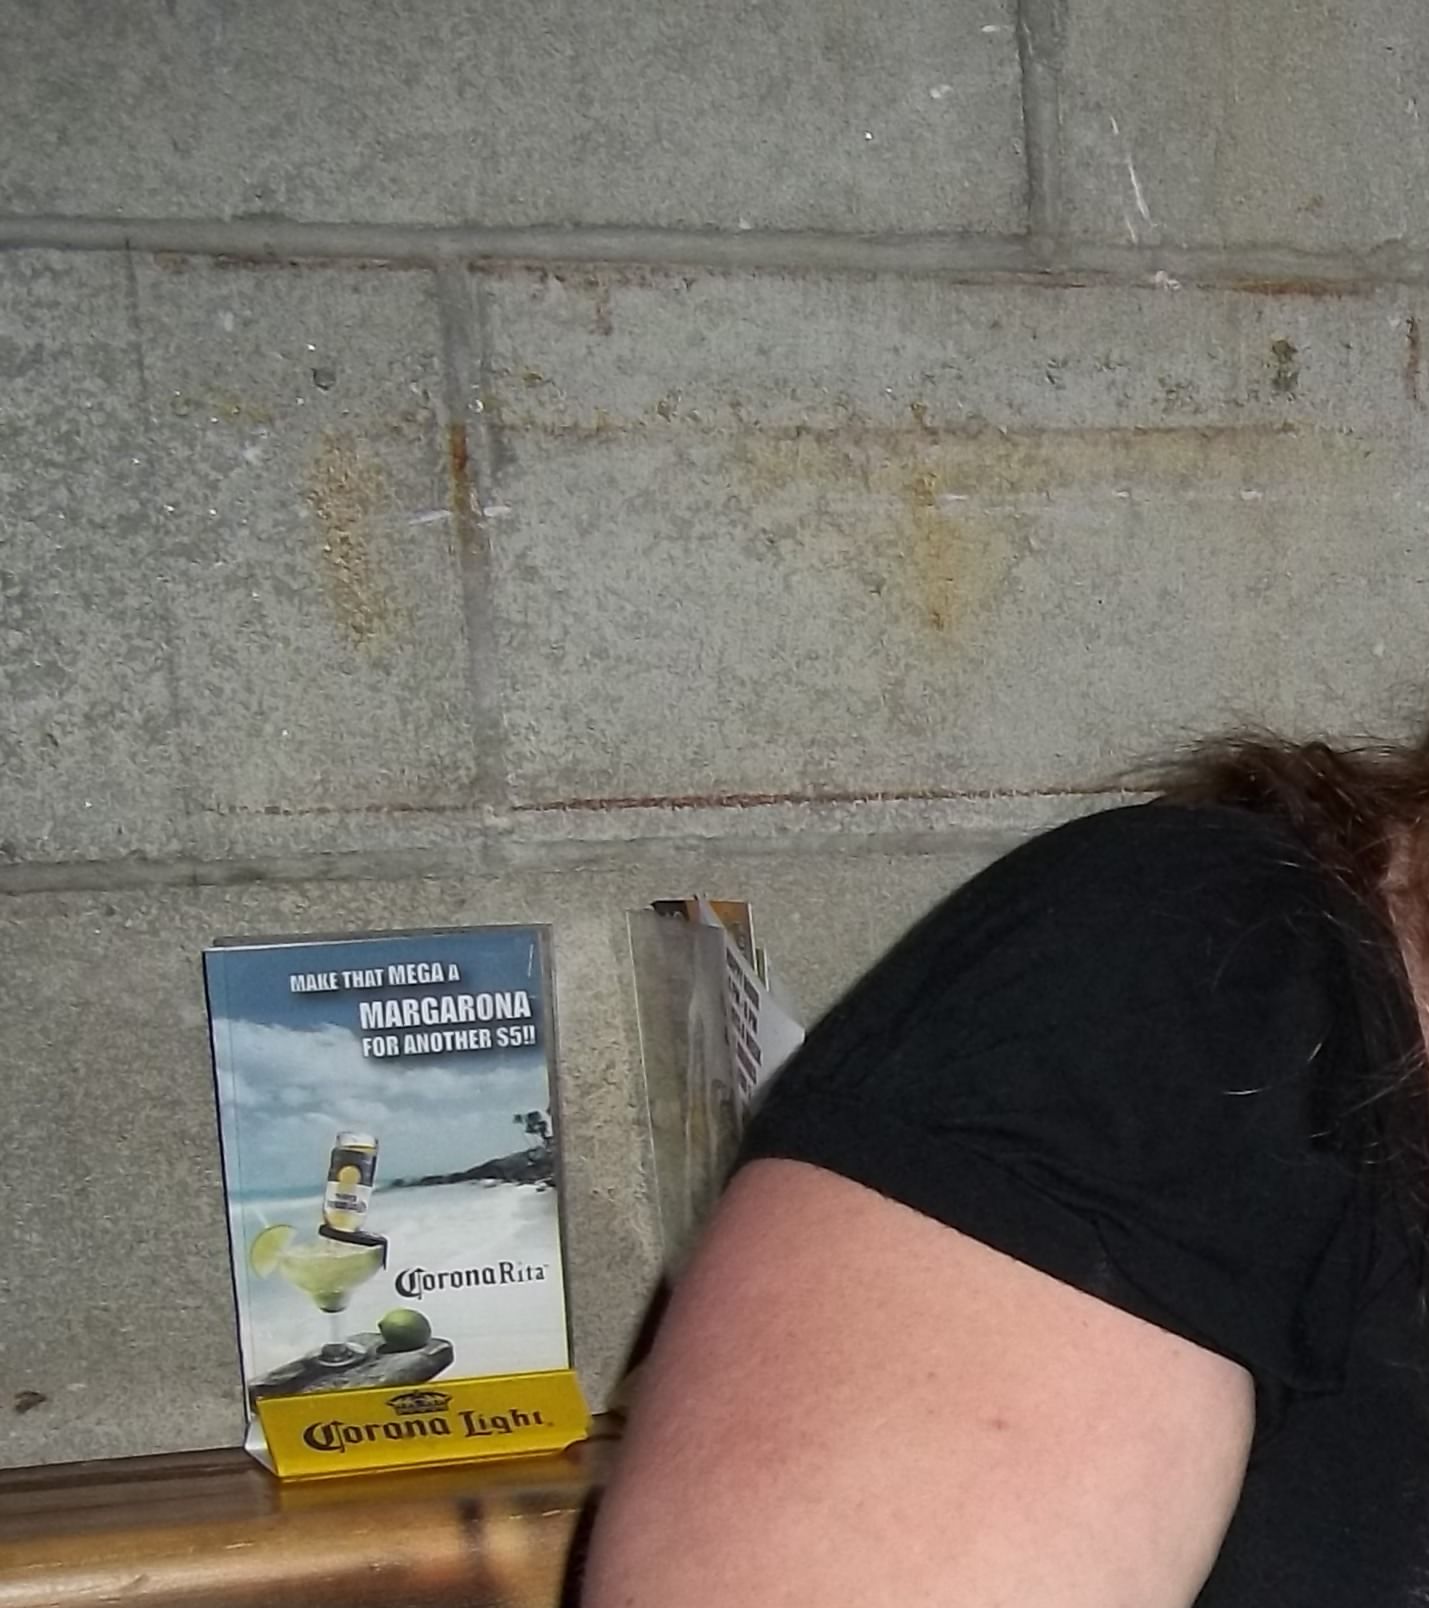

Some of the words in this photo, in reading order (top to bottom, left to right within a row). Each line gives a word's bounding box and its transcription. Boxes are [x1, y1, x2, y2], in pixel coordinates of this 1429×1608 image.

[290, 972, 339, 993] MAKE
[341, 968, 385, 989] THAT
[388, 961, 445, 986] MEGA
[447, 963, 461, 983] A
[359, 990, 533, 1030] MARGARONA
[362, 1034, 399, 1058] FOR
[403, 1029, 492, 1056] ANOTHER
[303, 1416, 451, 1454] Corona
[458, 1408, 545, 1438] Light
